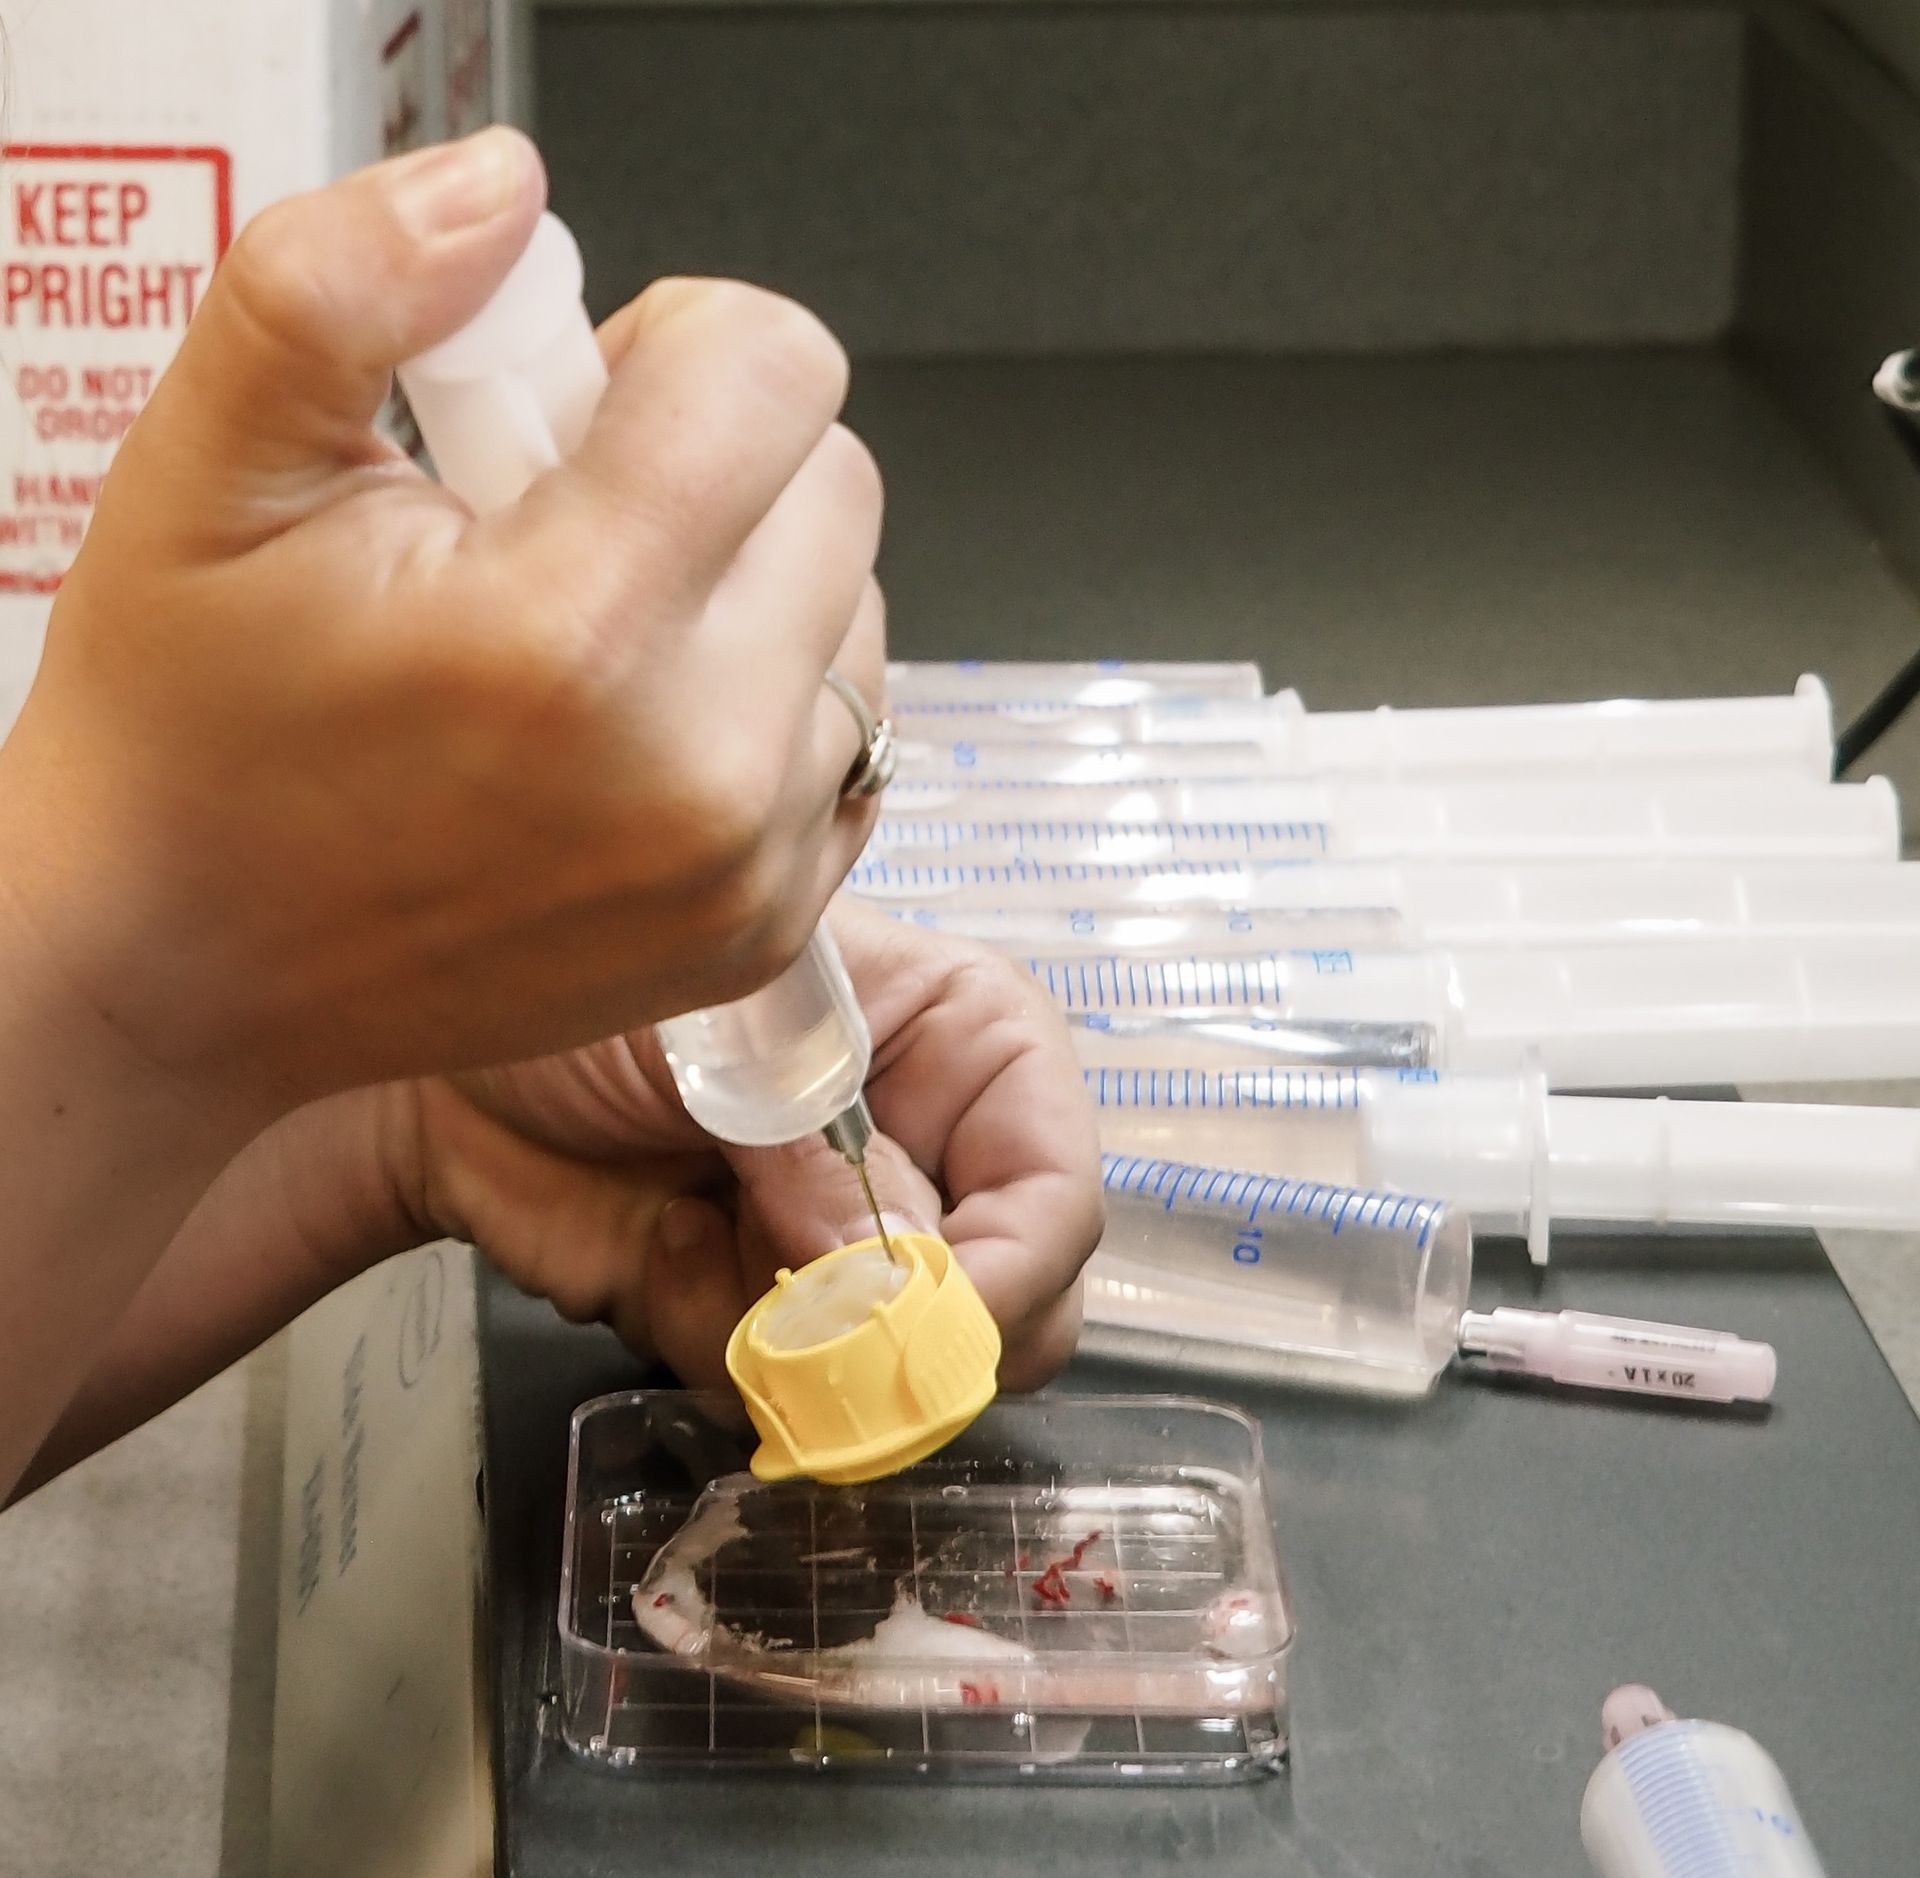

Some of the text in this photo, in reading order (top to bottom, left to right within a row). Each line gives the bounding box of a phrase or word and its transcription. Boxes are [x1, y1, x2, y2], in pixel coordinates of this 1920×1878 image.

[16, 182, 149, 246] KEEP
[4, 263, 201, 328] PRIGHT
[18, 366, 68, 401] DO
[1233, 1227, 1263, 1264] 10
